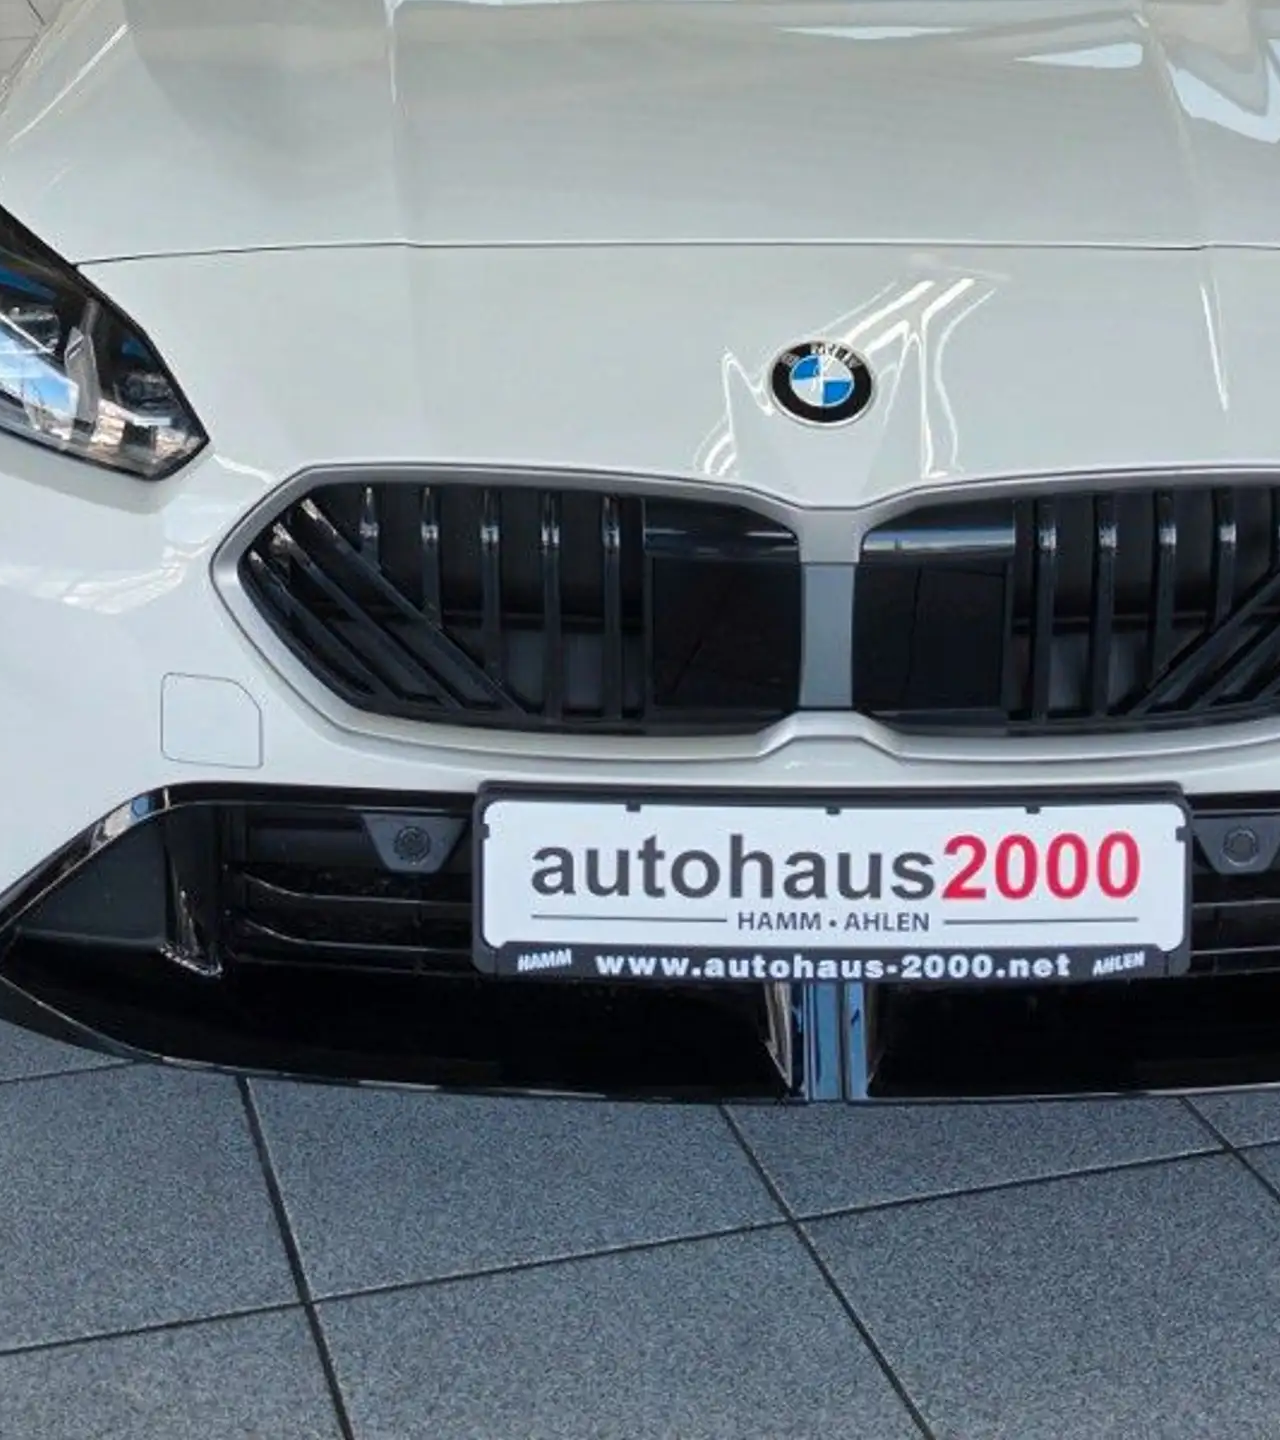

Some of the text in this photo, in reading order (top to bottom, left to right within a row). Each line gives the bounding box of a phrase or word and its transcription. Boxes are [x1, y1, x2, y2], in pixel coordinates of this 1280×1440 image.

[531, 831, 1141, 900] autohaus2000
[738, 911, 930, 933] HAMM AHLEN
[596, 954, 1071, 980] www.autohaus-2000.net
